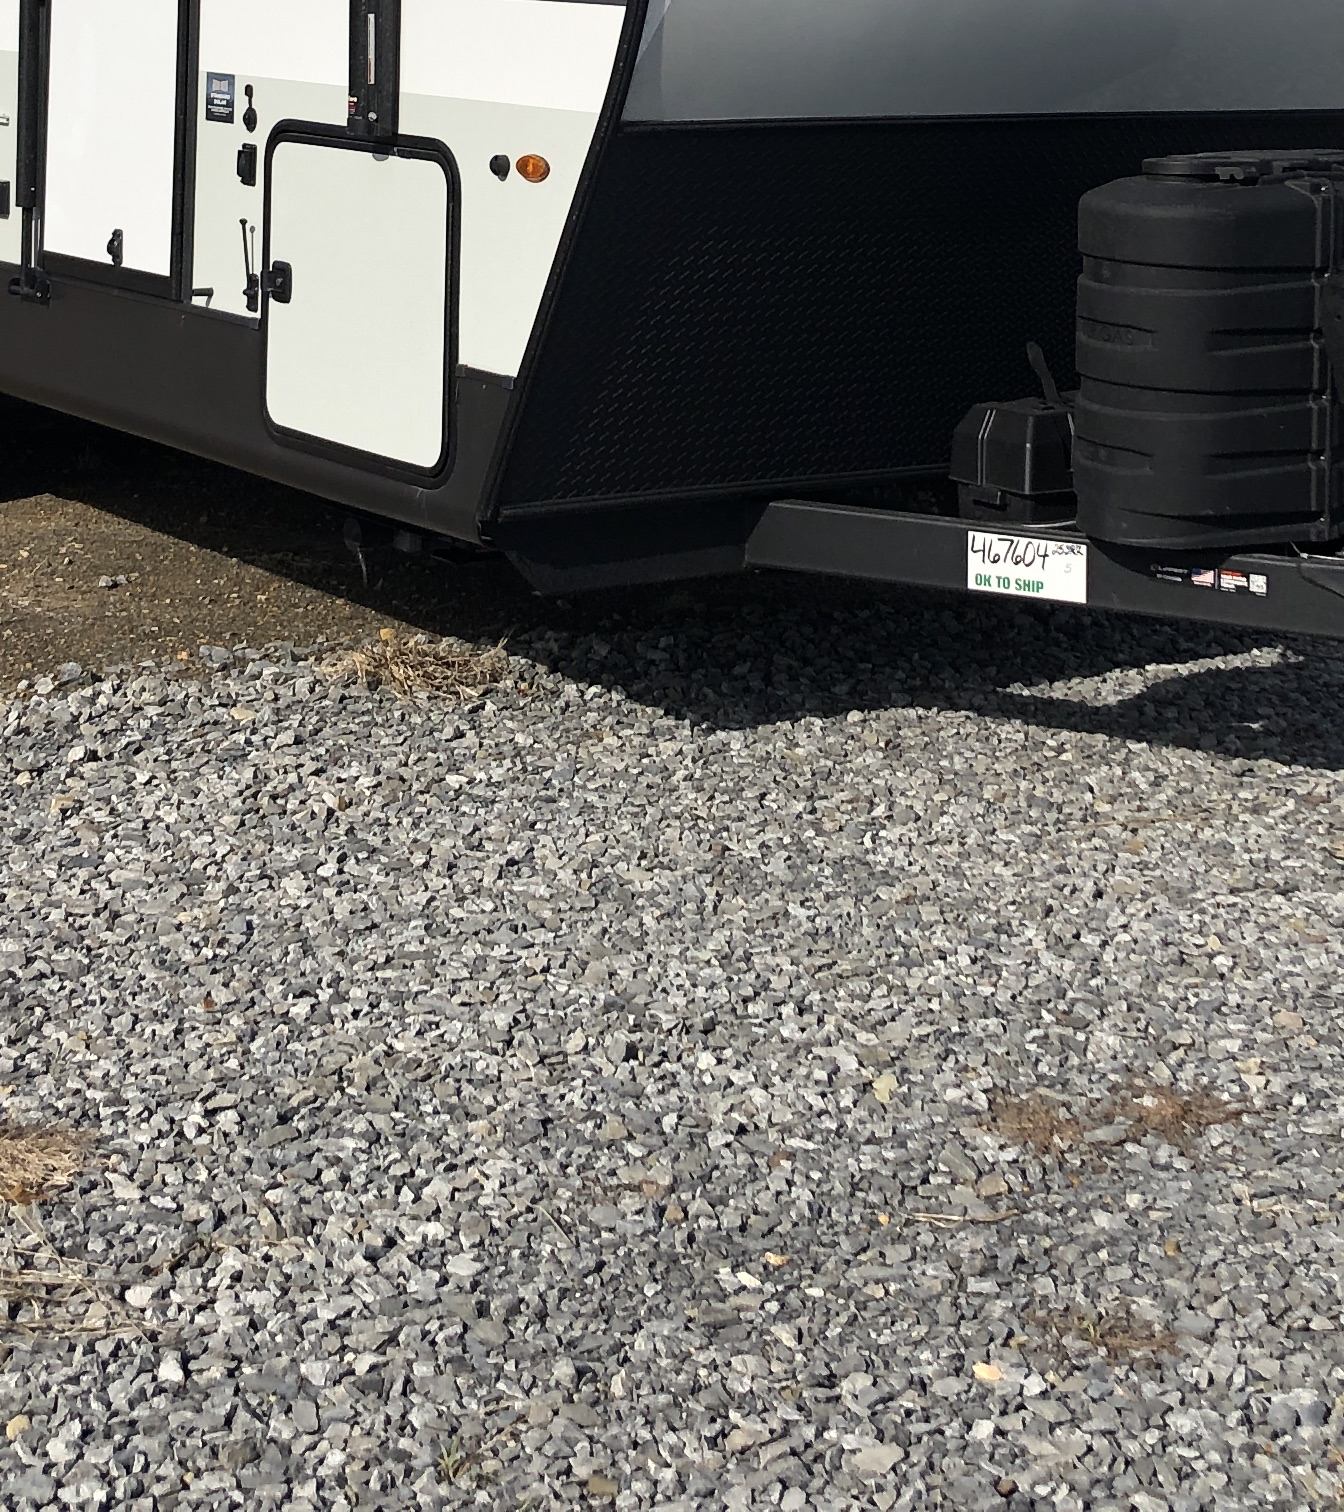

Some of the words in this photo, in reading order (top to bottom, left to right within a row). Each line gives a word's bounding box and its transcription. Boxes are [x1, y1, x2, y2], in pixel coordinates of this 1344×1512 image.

[970, 534, 1050, 571] 467604
[974, 573, 992, 587] OK
[996, 575, 1011, 590] TO
[1014, 577, 1044, 593] SHIP
